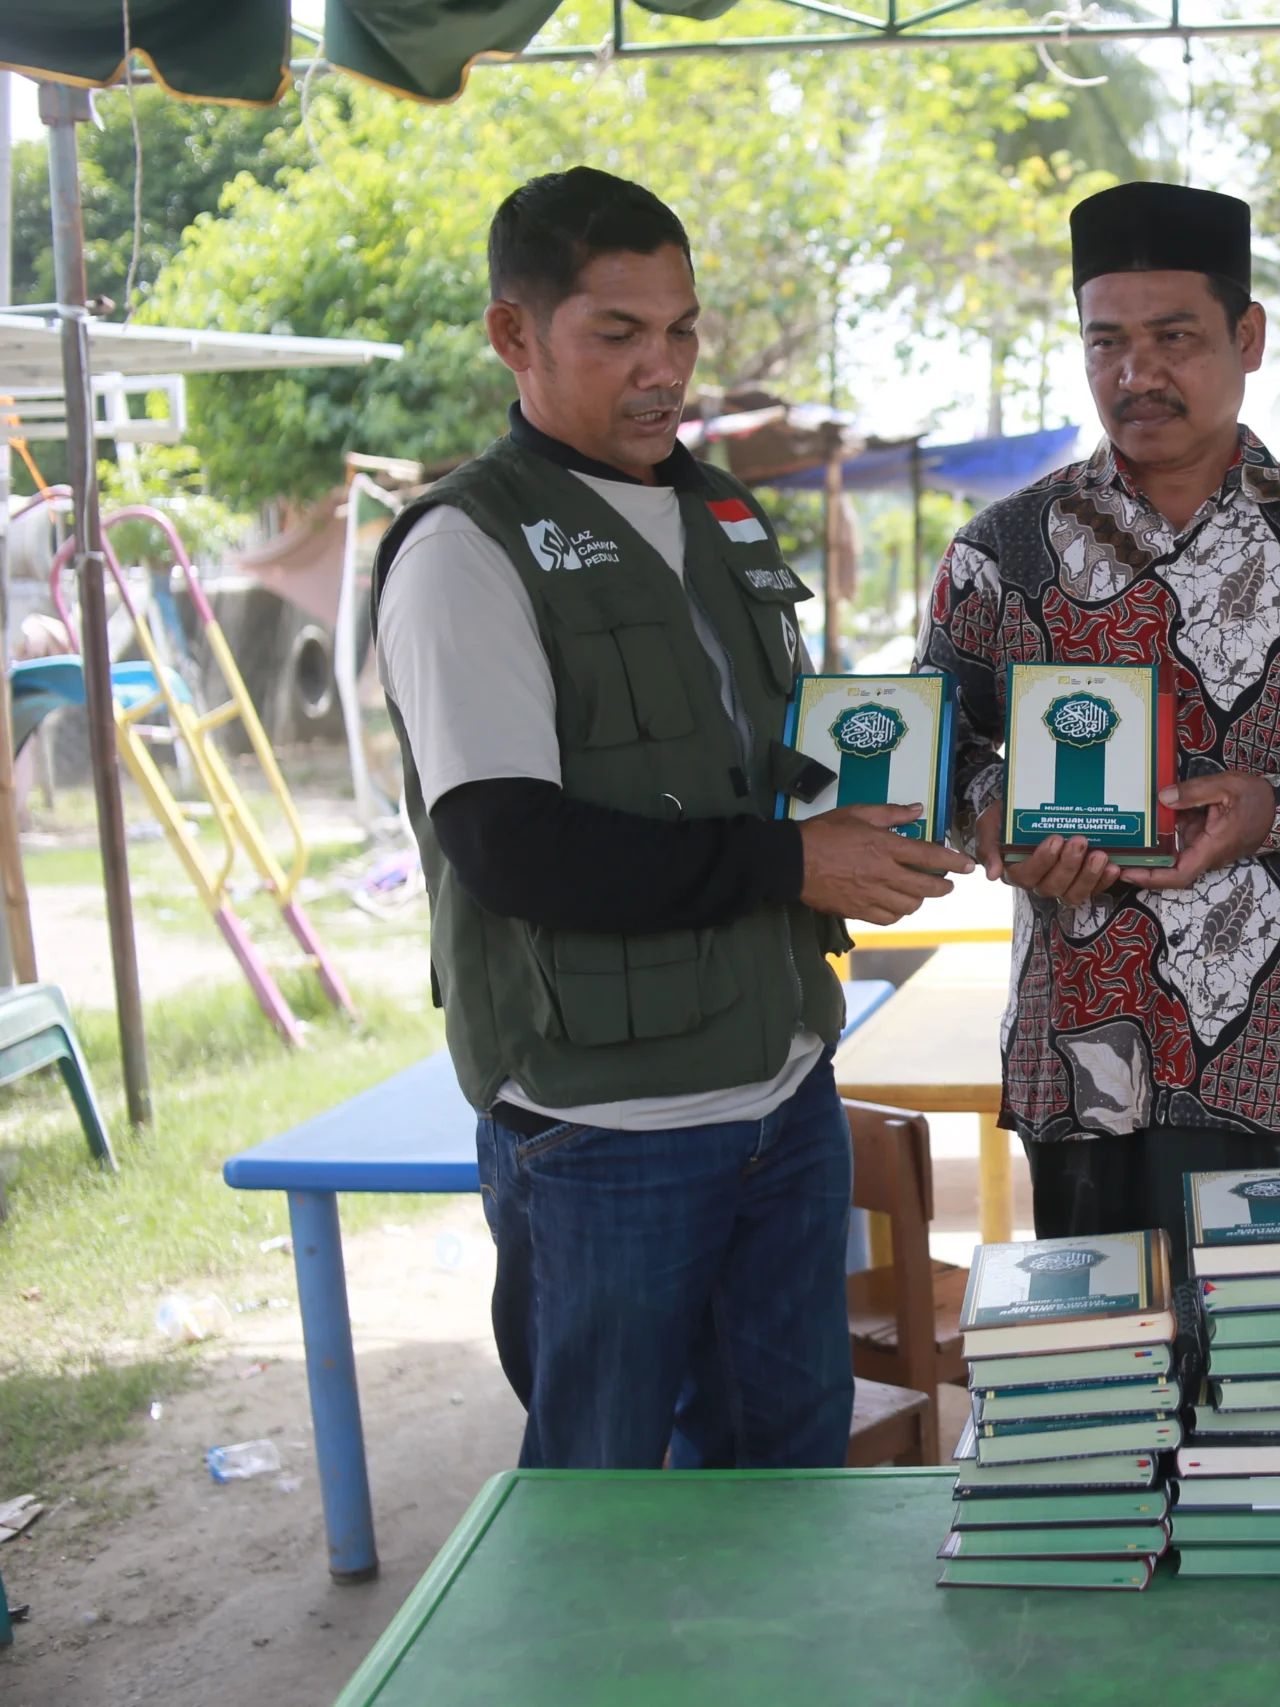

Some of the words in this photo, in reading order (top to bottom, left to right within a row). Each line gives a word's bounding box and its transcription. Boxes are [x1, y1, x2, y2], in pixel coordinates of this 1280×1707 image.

[570, 530, 594, 545] LAZ
[578, 541, 618, 556] CAHAYA
[584, 552, 620, 567] PEDULI
[1041, 816, 1084, 824] BANTUAN
[1077, 823, 1126, 831] SUMATERA
